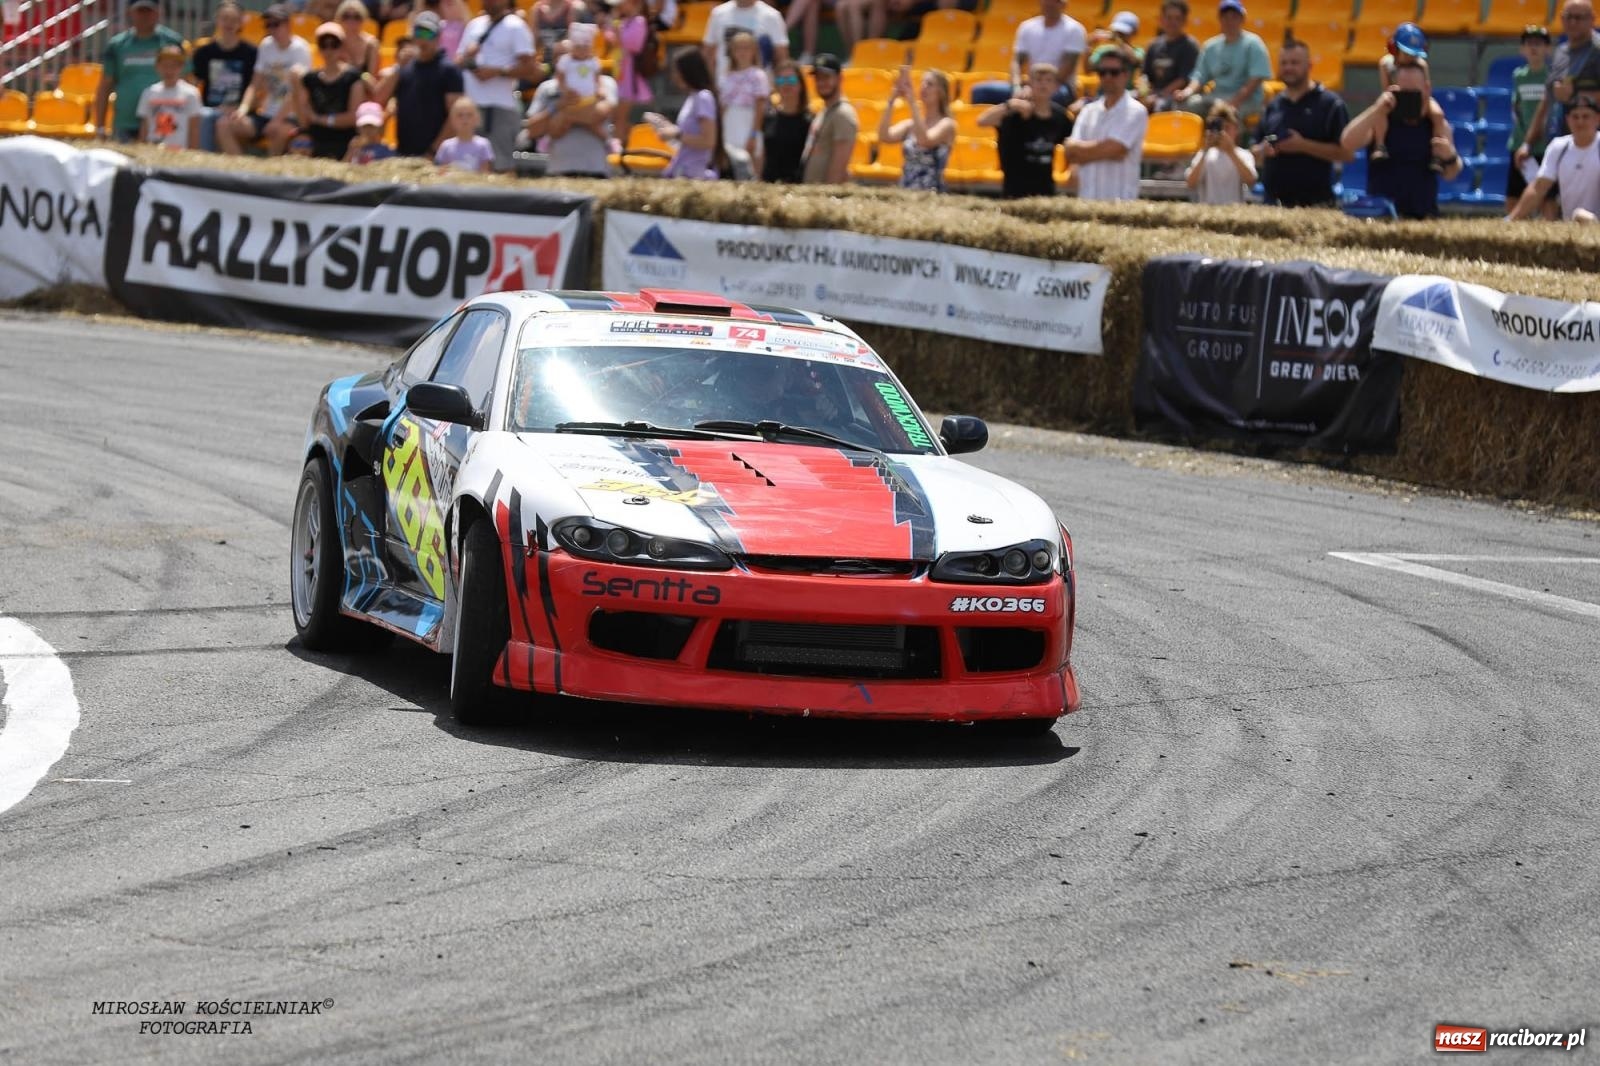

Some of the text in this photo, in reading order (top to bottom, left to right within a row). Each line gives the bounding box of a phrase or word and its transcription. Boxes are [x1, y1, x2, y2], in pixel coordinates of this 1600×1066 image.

[0, 184, 102, 237] NOVA
[142, 202, 492, 300] RALLYSHOP
[1033, 276, 1092, 300] SERWIS
[1178, 301, 1221, 322] AUTO
[1274, 296, 1366, 348] INEOS
[735, 327, 760, 339] 74
[1187, 339, 1243, 361] GROUP
[874, 382, 933, 447] TRACKWOOD
[581, 571, 721, 606] Sentta
